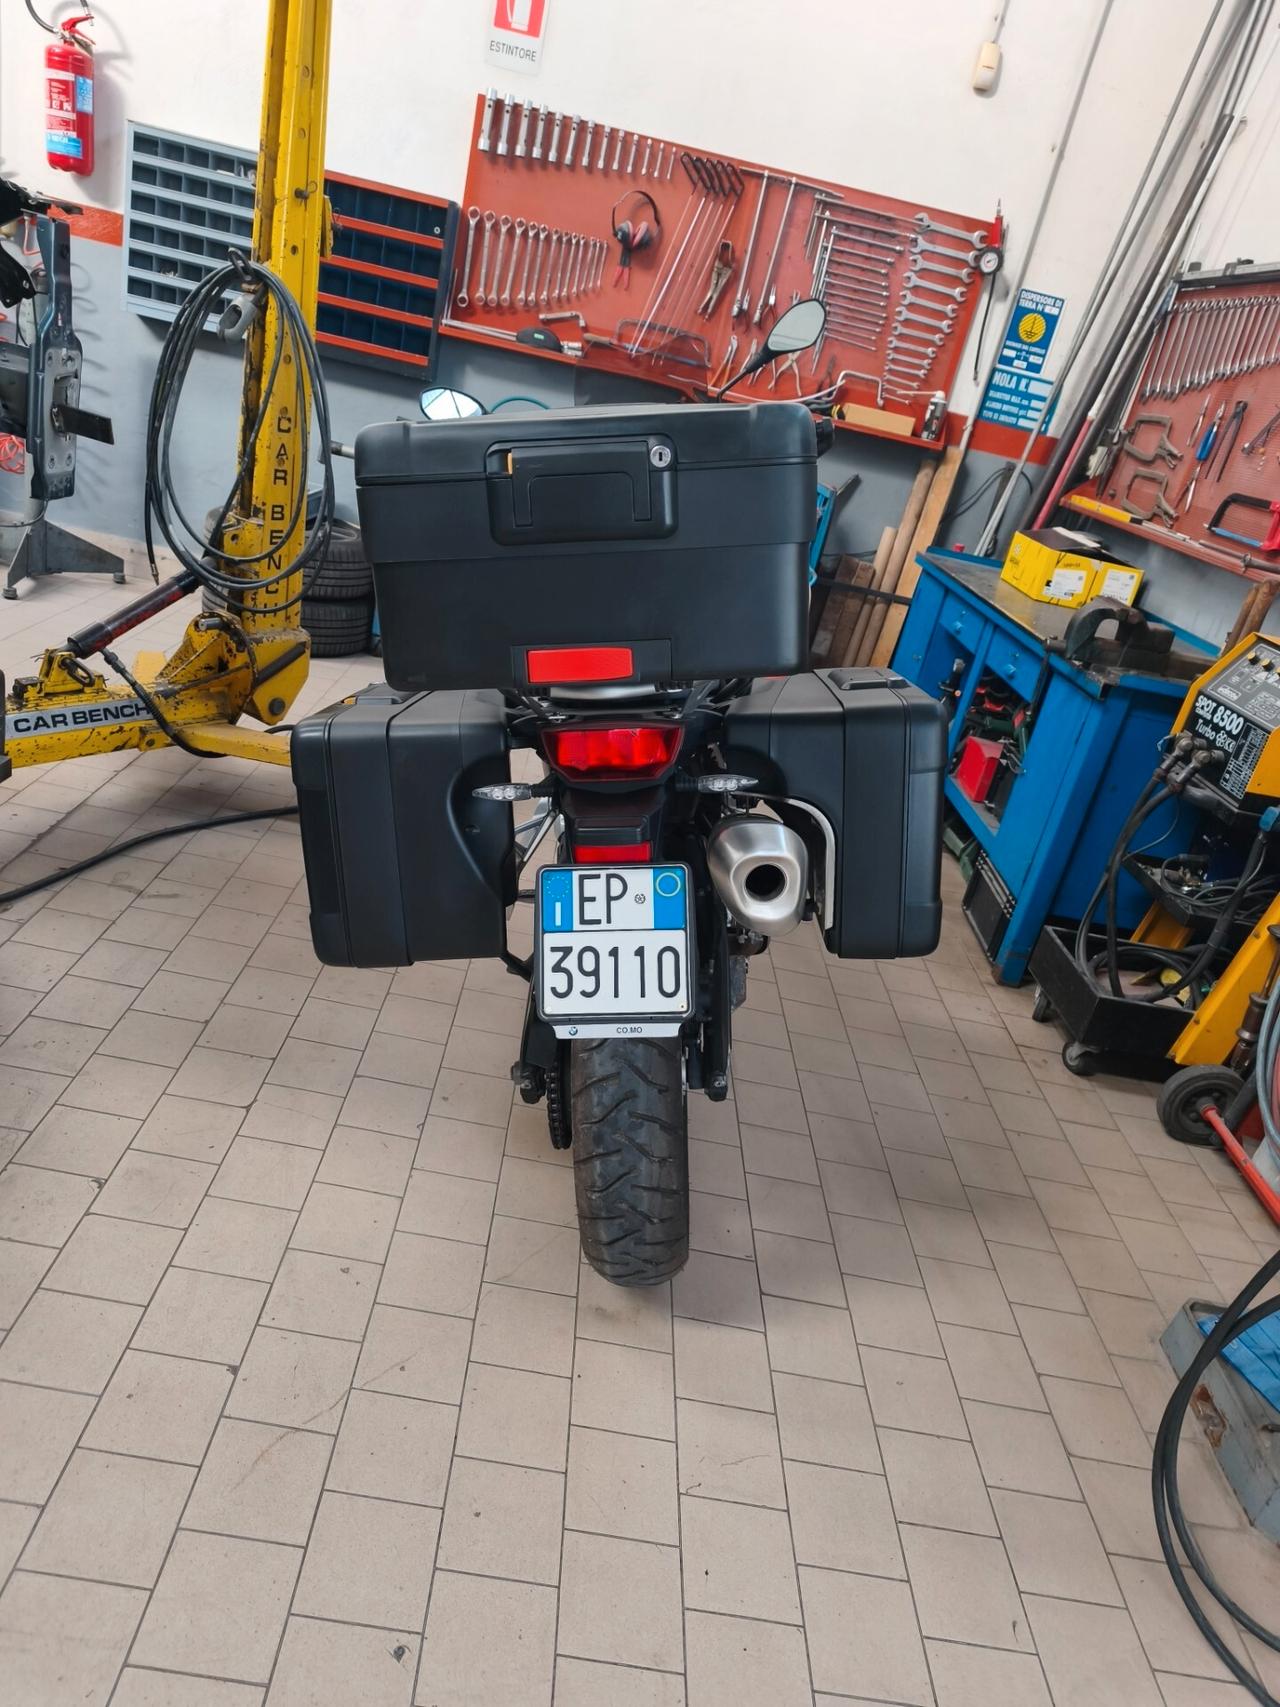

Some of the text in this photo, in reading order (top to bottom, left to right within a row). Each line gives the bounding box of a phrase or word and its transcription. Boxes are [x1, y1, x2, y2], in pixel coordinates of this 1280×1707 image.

[489, 39, 537, 62] ESTINTORE
[273, 416, 292, 486] CAR
[13, 712, 69, 733] CAR
[71, 702, 152, 726] BENCH
[1195, 694, 1217, 714] SPOT
[1212, 705, 1244, 735] 8500
[1195, 718, 1216, 740] Turbo
[578, 873, 628, 925] EP
[550, 945, 681, 999] 39110
